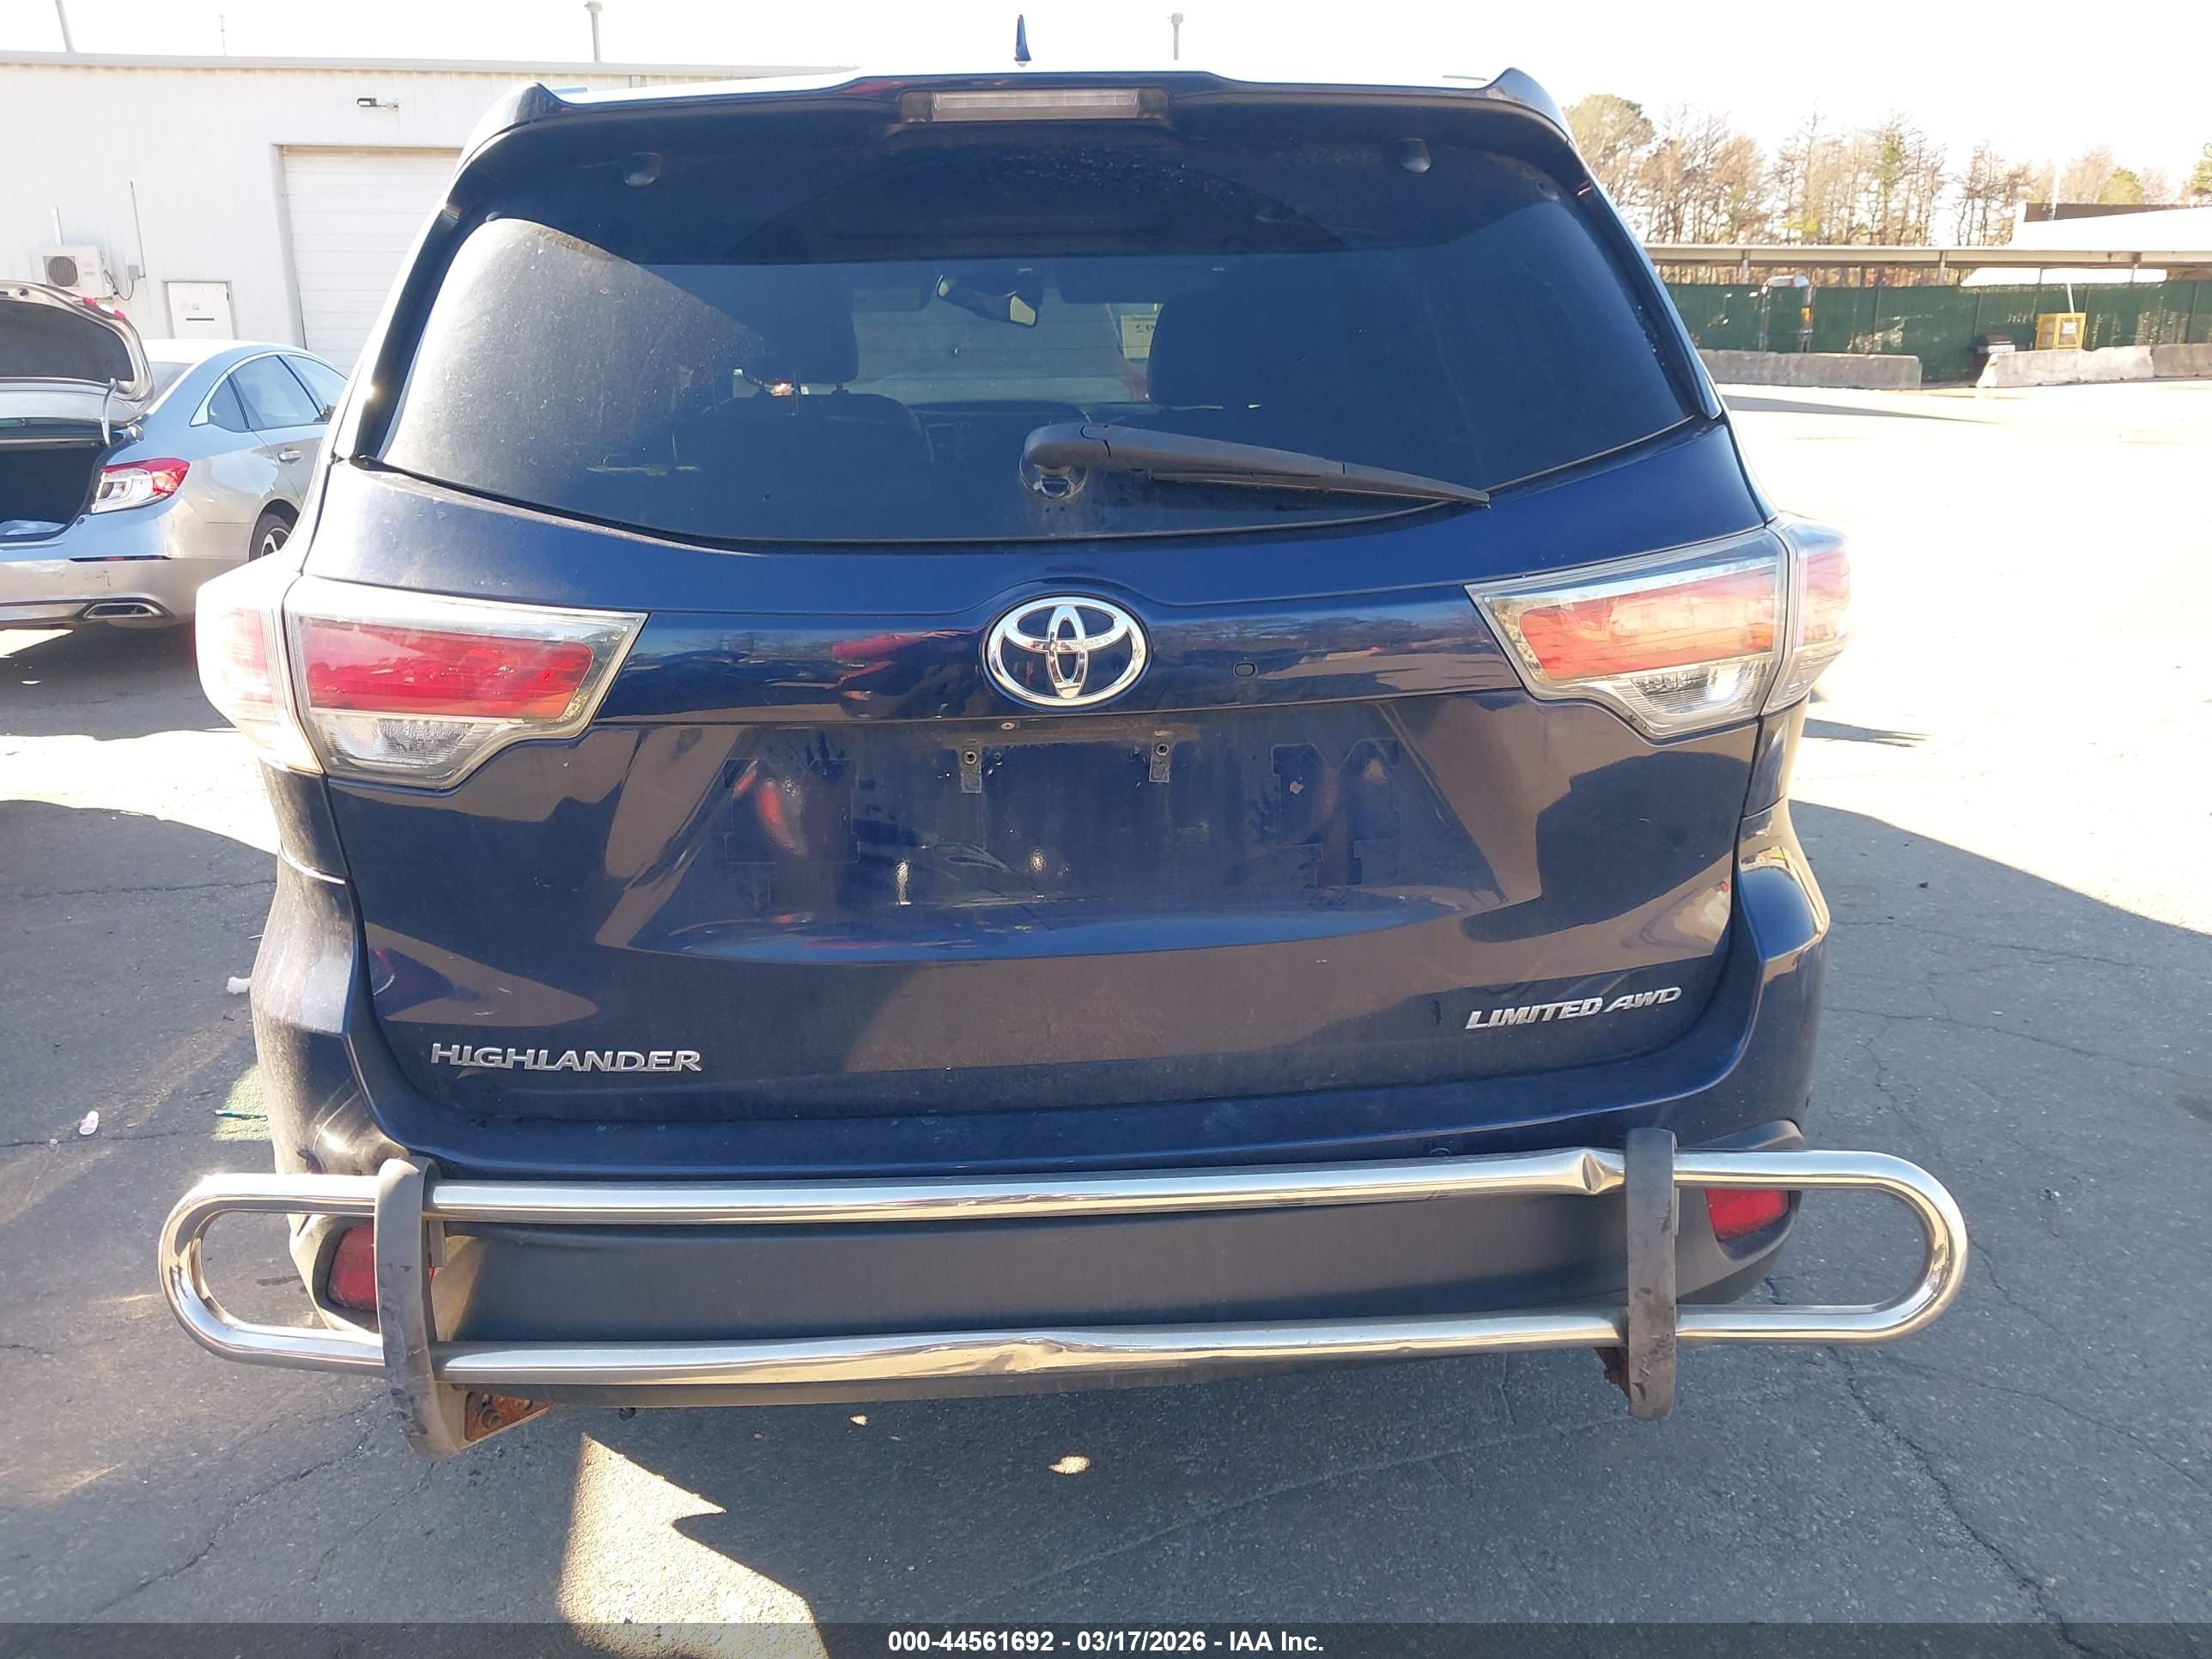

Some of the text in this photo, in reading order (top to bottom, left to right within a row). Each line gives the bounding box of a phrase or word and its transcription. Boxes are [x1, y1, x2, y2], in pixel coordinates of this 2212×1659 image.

[1464, 986, 1683, 1030] LIMITED AWD
[430, 1042, 702, 1073] HIGHLANDER
